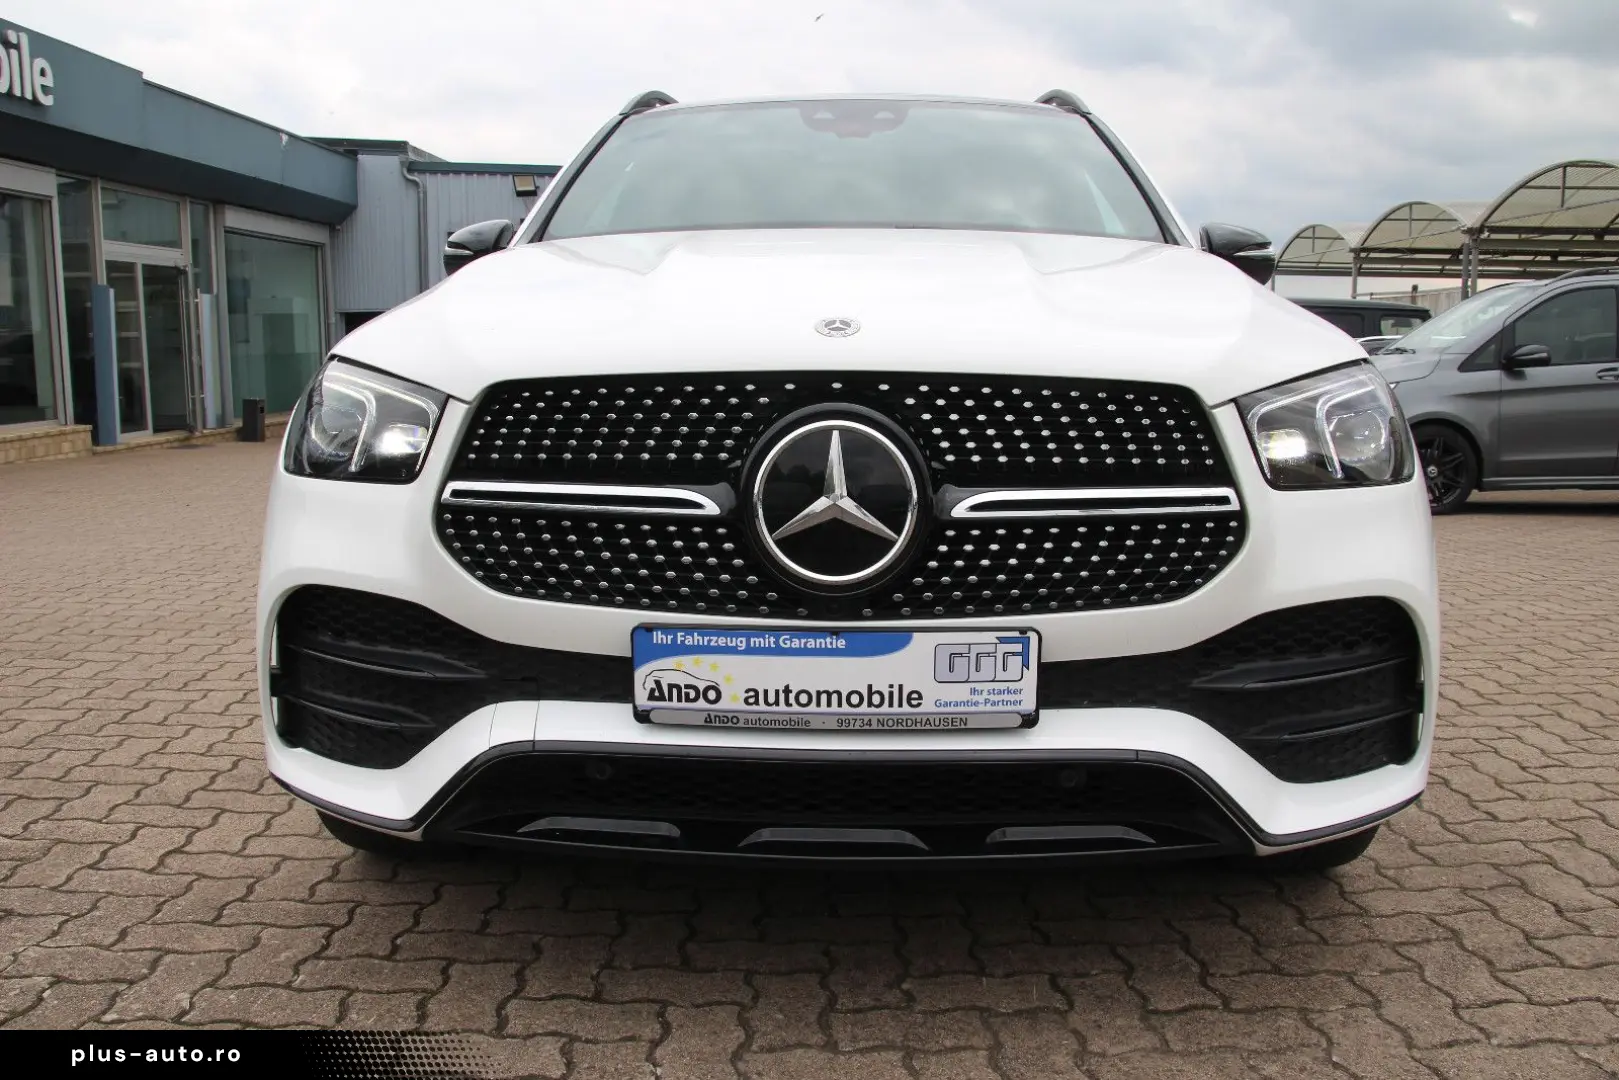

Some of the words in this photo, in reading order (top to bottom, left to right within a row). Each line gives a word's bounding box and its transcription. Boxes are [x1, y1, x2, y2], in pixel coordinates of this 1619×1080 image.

[653, 631, 674, 645] Ihr
[677, 633, 747, 649] Fahrzeug
[750, 635, 775, 648] mit
[779, 636, 846, 649] Garantie
[743, 684, 924, 708] automobile
[970, 686, 984, 696] Ihr
[987, 686, 1023, 696] starker
[935, 698, 1023, 708] Garantie-Partner
[743, 717, 810, 728] automobile
[837, 718, 872, 728] 99734
[876, 717, 968, 728] NORDHAUSEN
